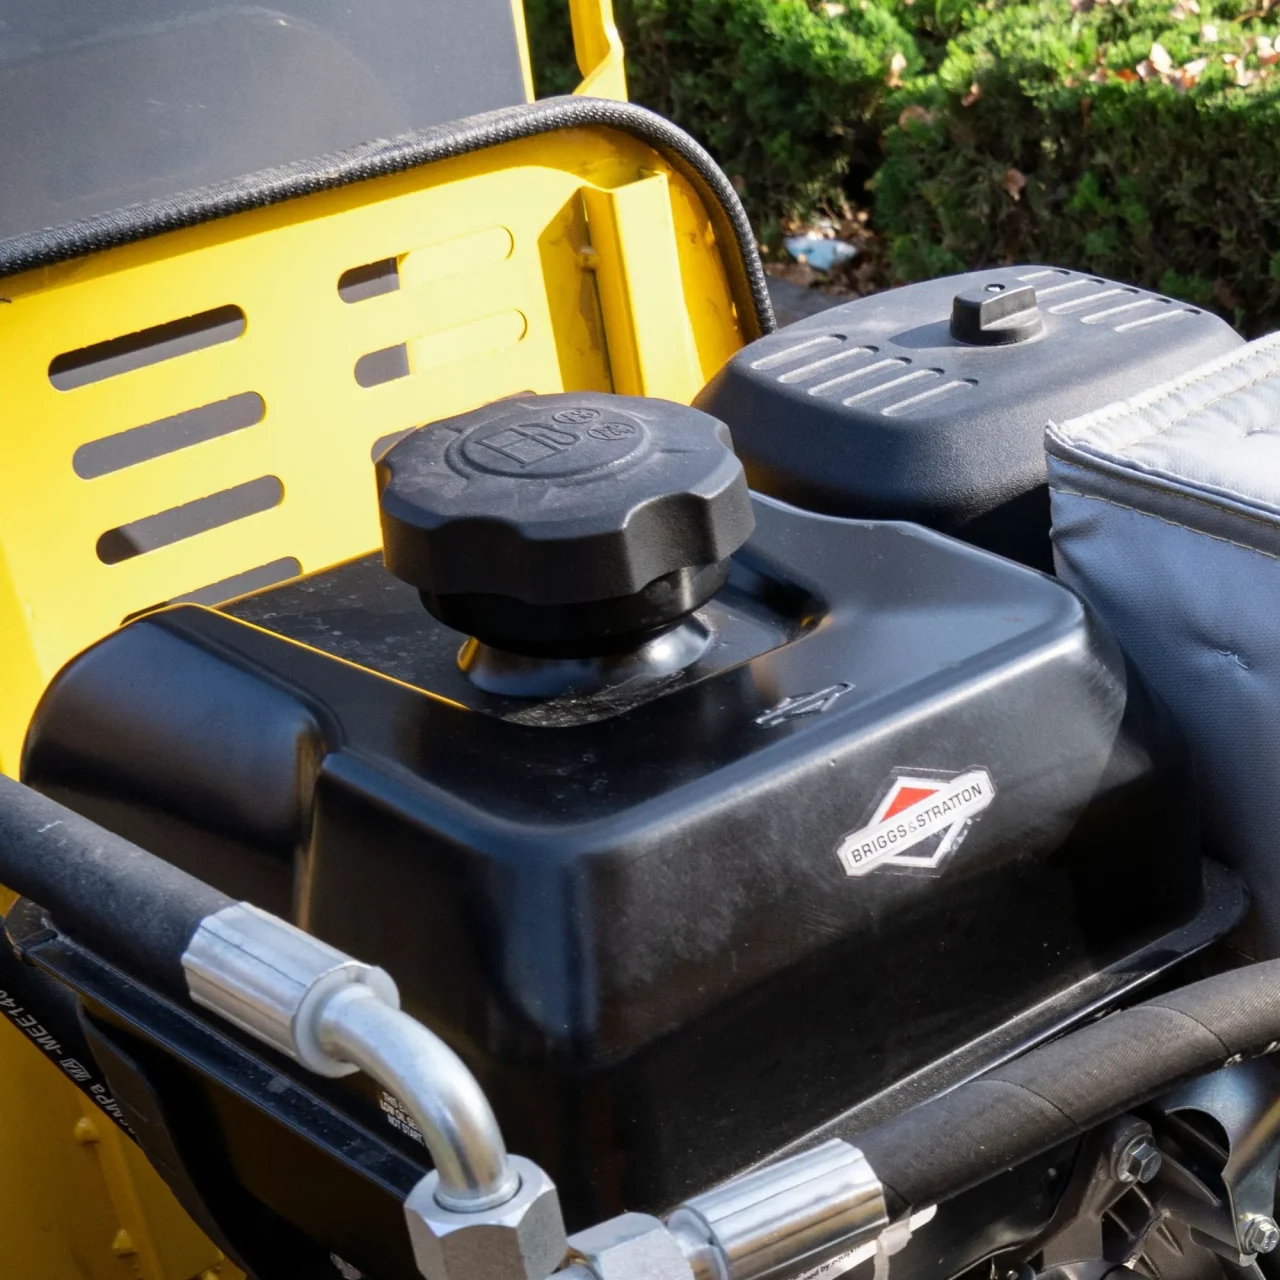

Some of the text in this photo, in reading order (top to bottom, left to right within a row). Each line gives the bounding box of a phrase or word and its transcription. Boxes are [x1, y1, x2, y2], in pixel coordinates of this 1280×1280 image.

[851, 824, 907, 863] BRIGGS
[916, 783, 982, 828] STRATTON
[820, 1264, 831, 1274] by
